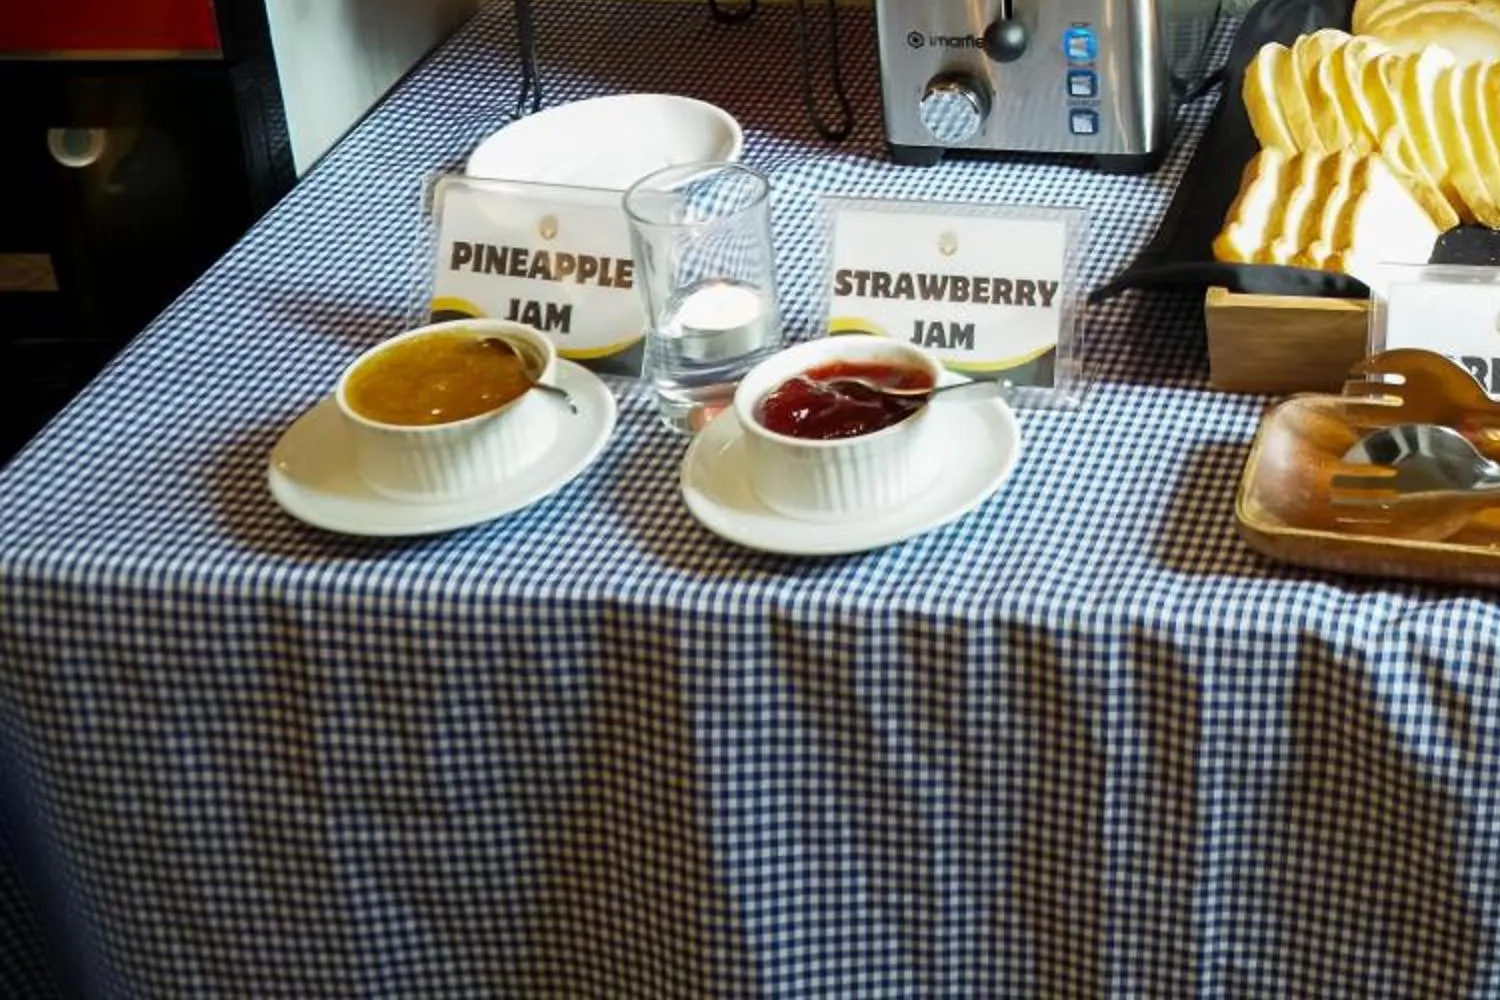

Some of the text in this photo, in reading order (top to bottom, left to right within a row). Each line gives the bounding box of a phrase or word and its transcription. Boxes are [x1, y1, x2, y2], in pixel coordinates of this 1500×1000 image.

[929, 34, 985, 50] imarfle
[450, 242, 635, 289] PINEAPPLE
[834, 269, 1059, 307] STRAWBERRY
[504, 298, 573, 334] JAM
[910, 320, 975, 350] JAM
